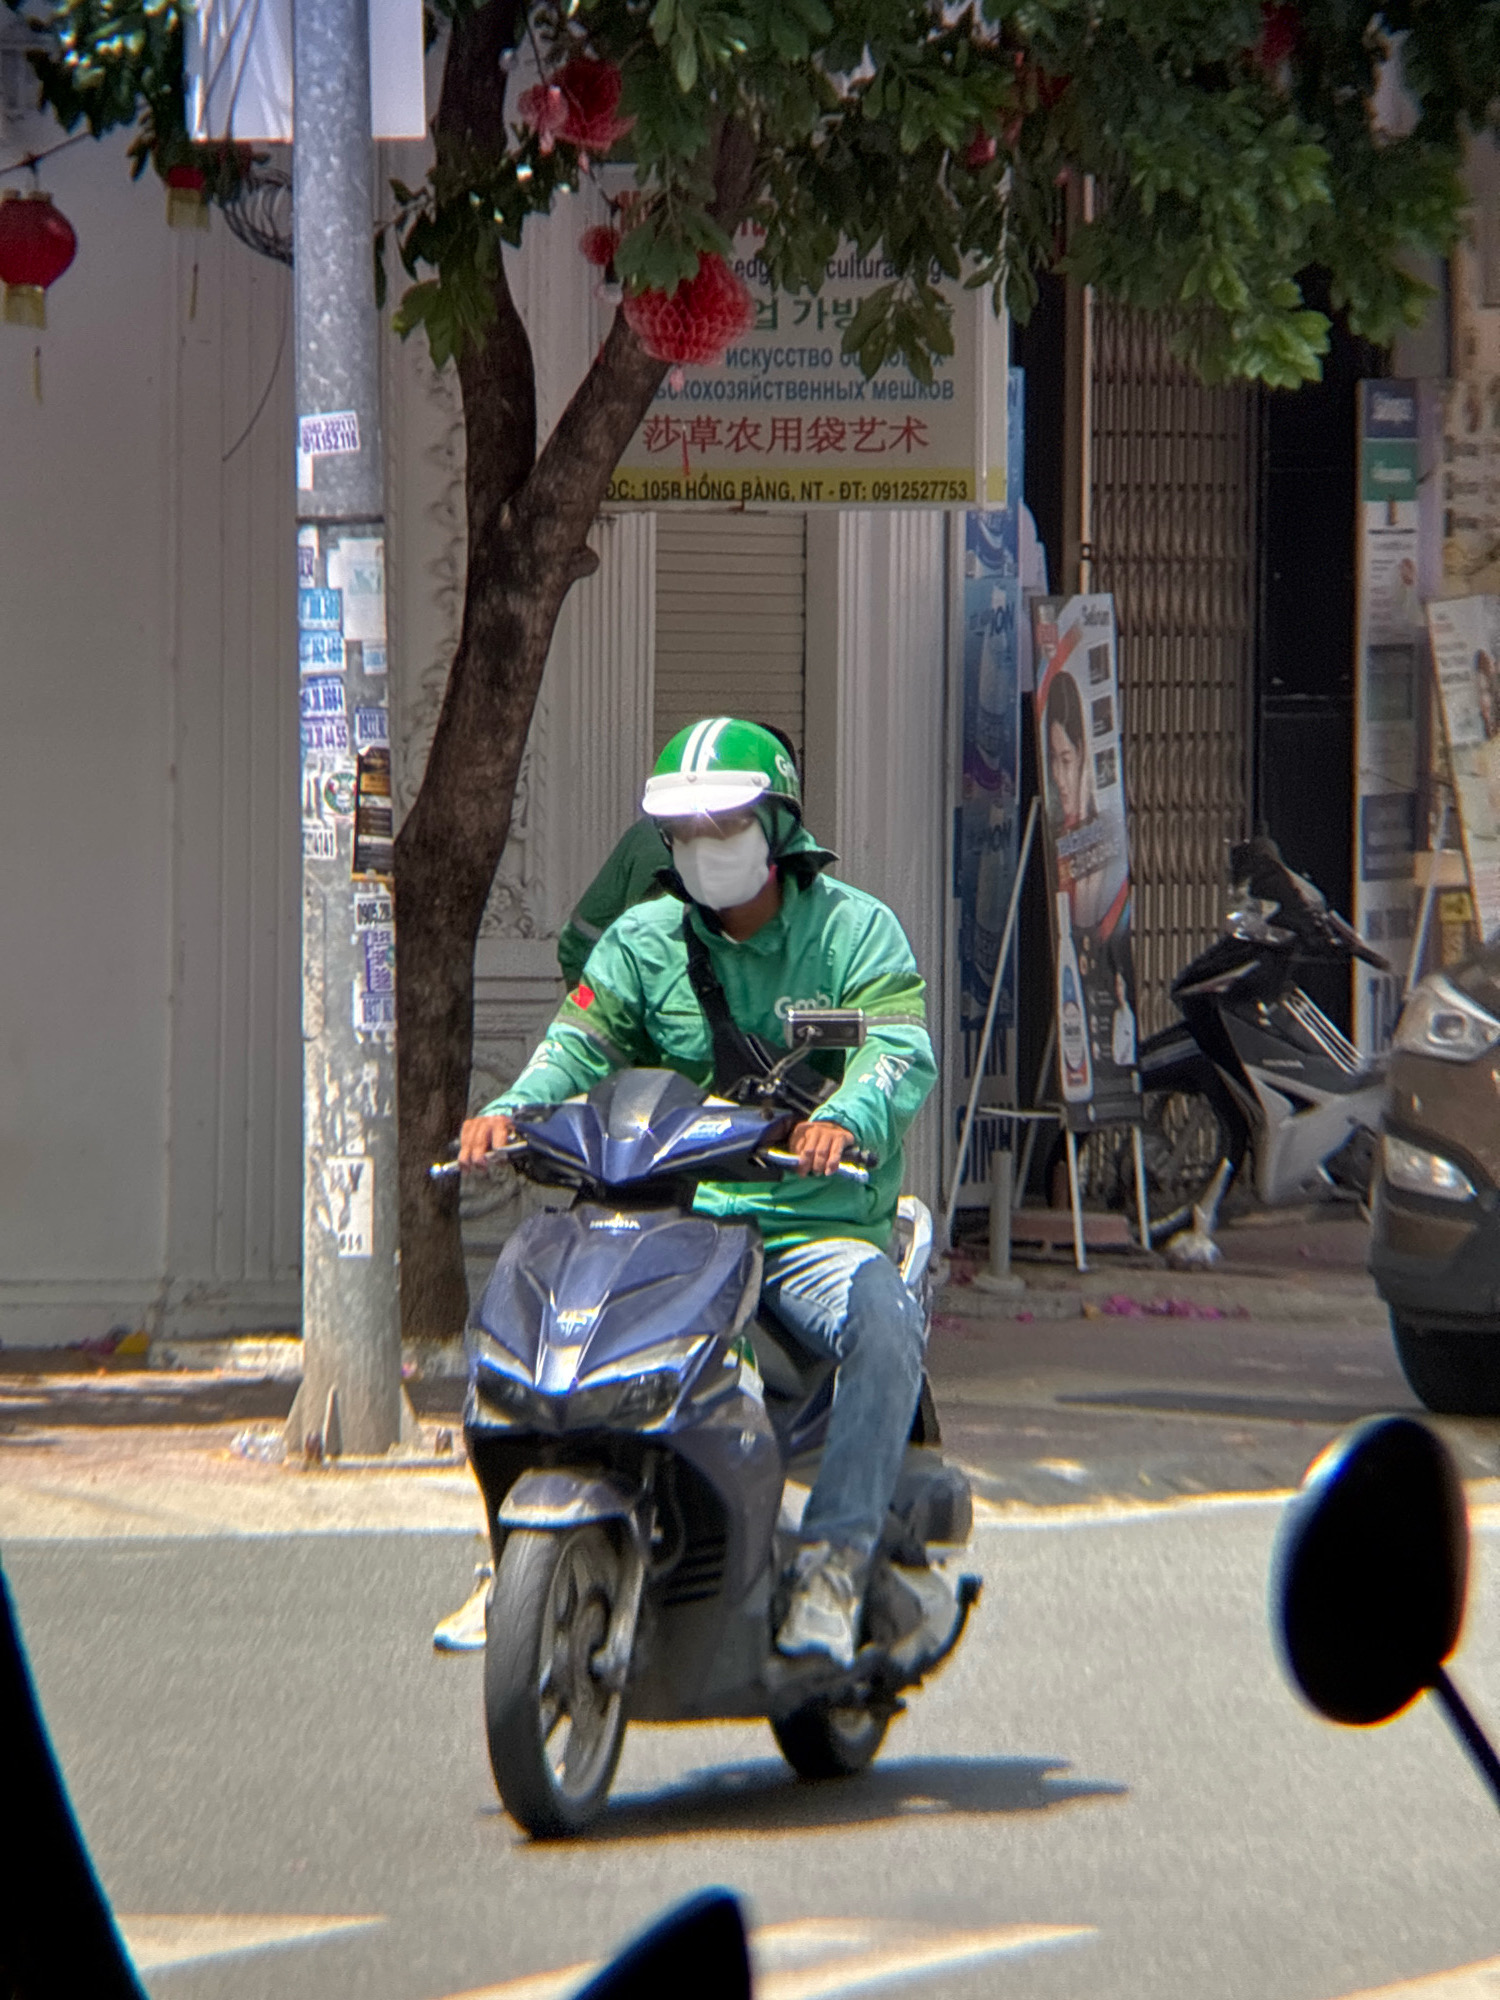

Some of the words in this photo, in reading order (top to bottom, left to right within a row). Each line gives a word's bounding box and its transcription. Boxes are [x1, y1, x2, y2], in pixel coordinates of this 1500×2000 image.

[725, 347, 833, 374] искусство
[871, 378, 955, 401] мешков
[643, 415, 929, 453] 莎草农用袋艺术
[641, 479, 681, 500] 105B
[800, 479, 824, 500] NT
[839, 479, 867, 500] ĐT:
[871, 479, 968, 500] 0912527753
